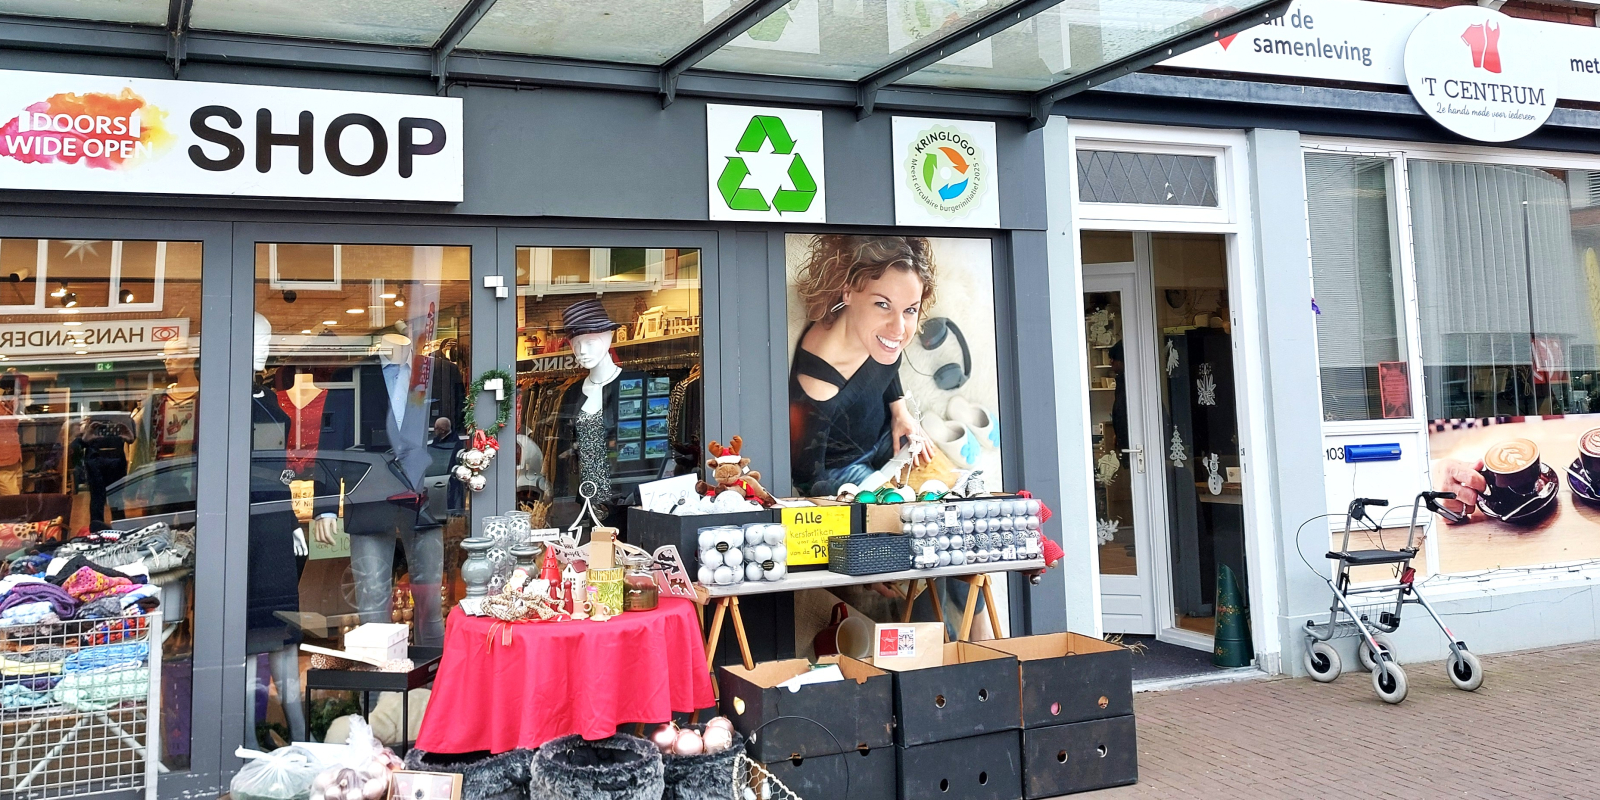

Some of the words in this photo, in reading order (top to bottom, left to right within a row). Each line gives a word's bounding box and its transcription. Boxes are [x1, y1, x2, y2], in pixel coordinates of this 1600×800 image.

[1291, 8, 1314, 30] de
[1253, 37, 1373, 67] samenleving
[1570, 58, 1600, 74] met
[1421, 76, 1437, 96] 'T
[1444, 79, 1546, 106] CENTRUM
[1436, 101, 1446, 114] 2e
[1447, 103, 1470, 115] hands
[1471, 106, 1490, 117] mode
[1491, 111, 1507, 119] voor
[1508, 109, 1536, 120] iedereen
[33, 112, 127, 135] DOORS
[5, 134, 77, 157] WIDE
[82, 138, 153, 159] OPEN
[188, 104, 447, 179] SHOP
[914, 131, 975, 156] KRINGLOGO
[910, 158, 918, 182] Meest
[913, 182, 939, 209] circulaire
[939, 182, 979, 213] burgerinitiatief
[1326, 446, 1345, 461] 103
[794, 511, 823, 525] Alle
[811, 543, 829, 558] PR
